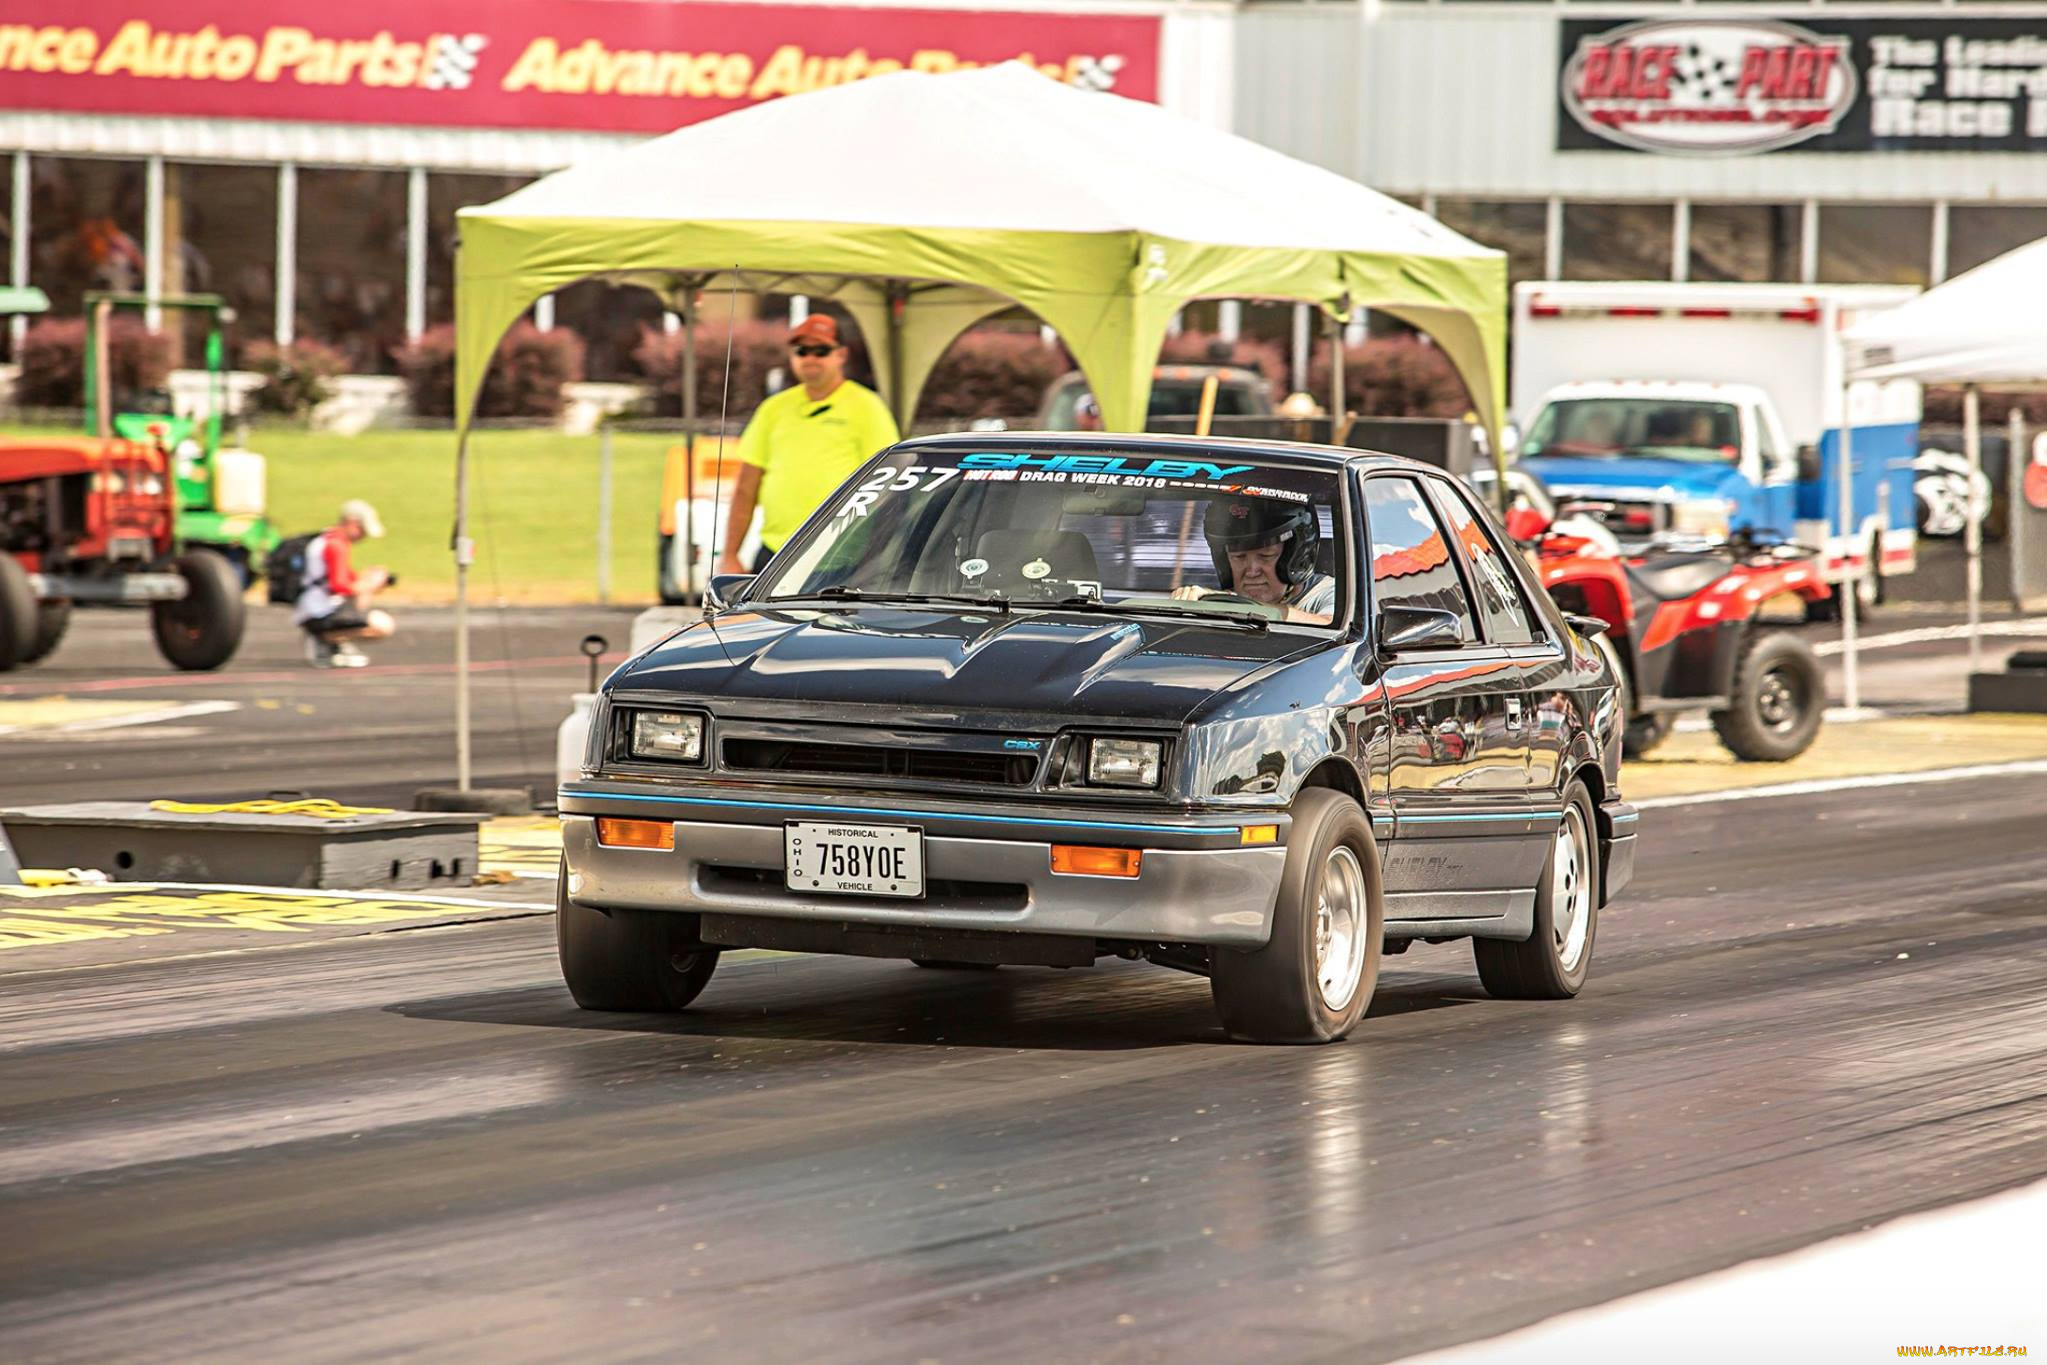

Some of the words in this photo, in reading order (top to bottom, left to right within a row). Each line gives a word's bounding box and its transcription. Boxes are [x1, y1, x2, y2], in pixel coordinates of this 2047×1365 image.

[92, 19, 258, 82] Auto
[254, 24, 424, 88] Parts
[1868, 34, 1938, 67] The
[500, 36, 753, 99] Advance
[1579, 45, 1680, 99] RACE
[1736, 45, 1840, 99] PART
[1867, 66, 1937, 98] for
[1870, 98, 2013, 138] Race
[858, 466, 961, 492] 257
[957, 453, 1255, 481] SHELBY
[1019, 471, 1067, 482] DRAG
[1071, 473, 1121, 485] WEEK
[836, 491, 880, 517] R
[828, 828, 879, 838] HISTORICAL
[792, 838, 803, 877] OHIO
[816, 843, 907, 879] 758YOE
[837, 881, 873, 891] VEHICLE
